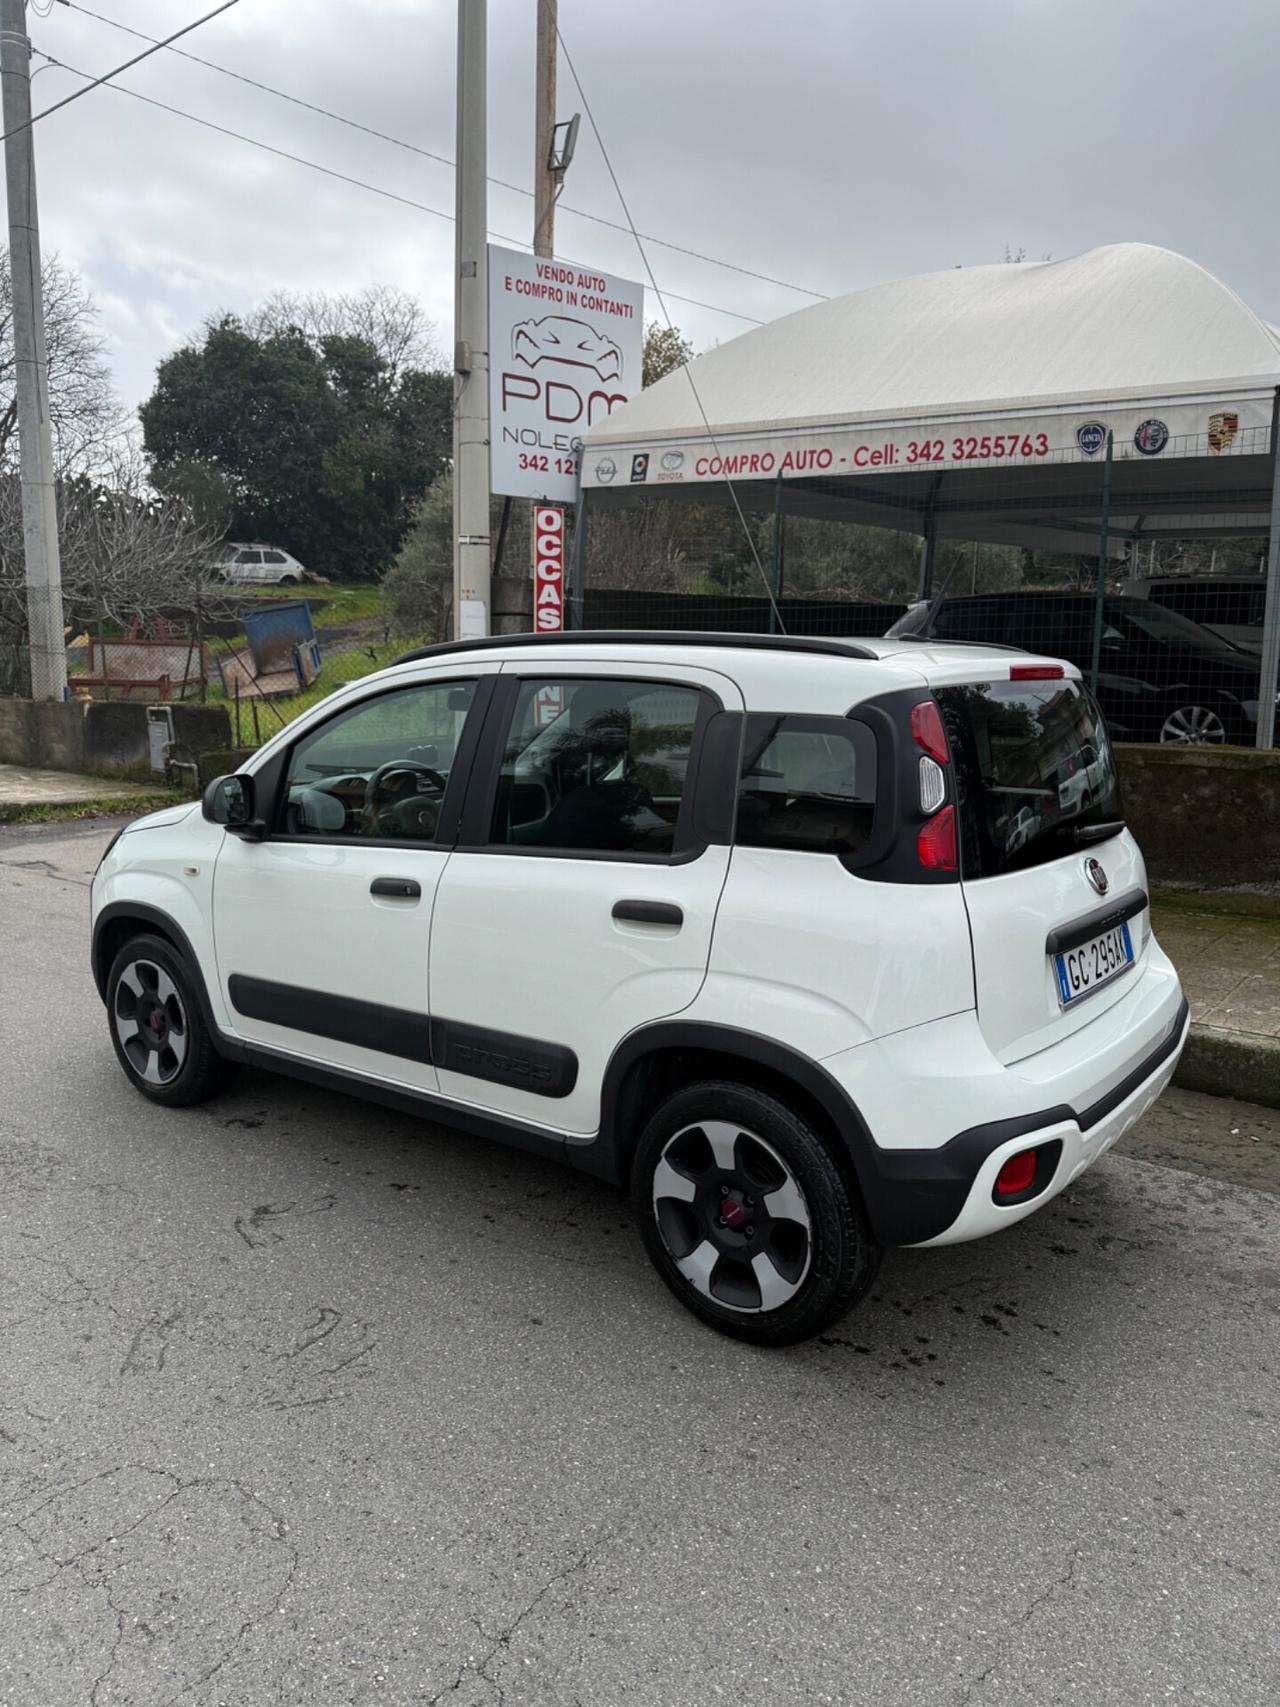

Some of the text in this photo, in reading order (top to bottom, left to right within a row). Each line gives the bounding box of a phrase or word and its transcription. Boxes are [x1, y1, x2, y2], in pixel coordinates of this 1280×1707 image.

[536, 262, 606, 293] VENDO AUTO
[504, 275, 633, 319] E COMPRO IN CONTANTI
[502, 426, 583, 452] NOLEG
[695, 451, 775, 476] COMPRO
[780, 447, 833, 471] AUTO
[853, 443, 900, 467] Cell:
[905, 440, 945, 464] 342
[951, 432, 1050, 461] 3255763
[518, 452, 549, 473] 342
[1067, 928, 1128, 991] GC 295AK
